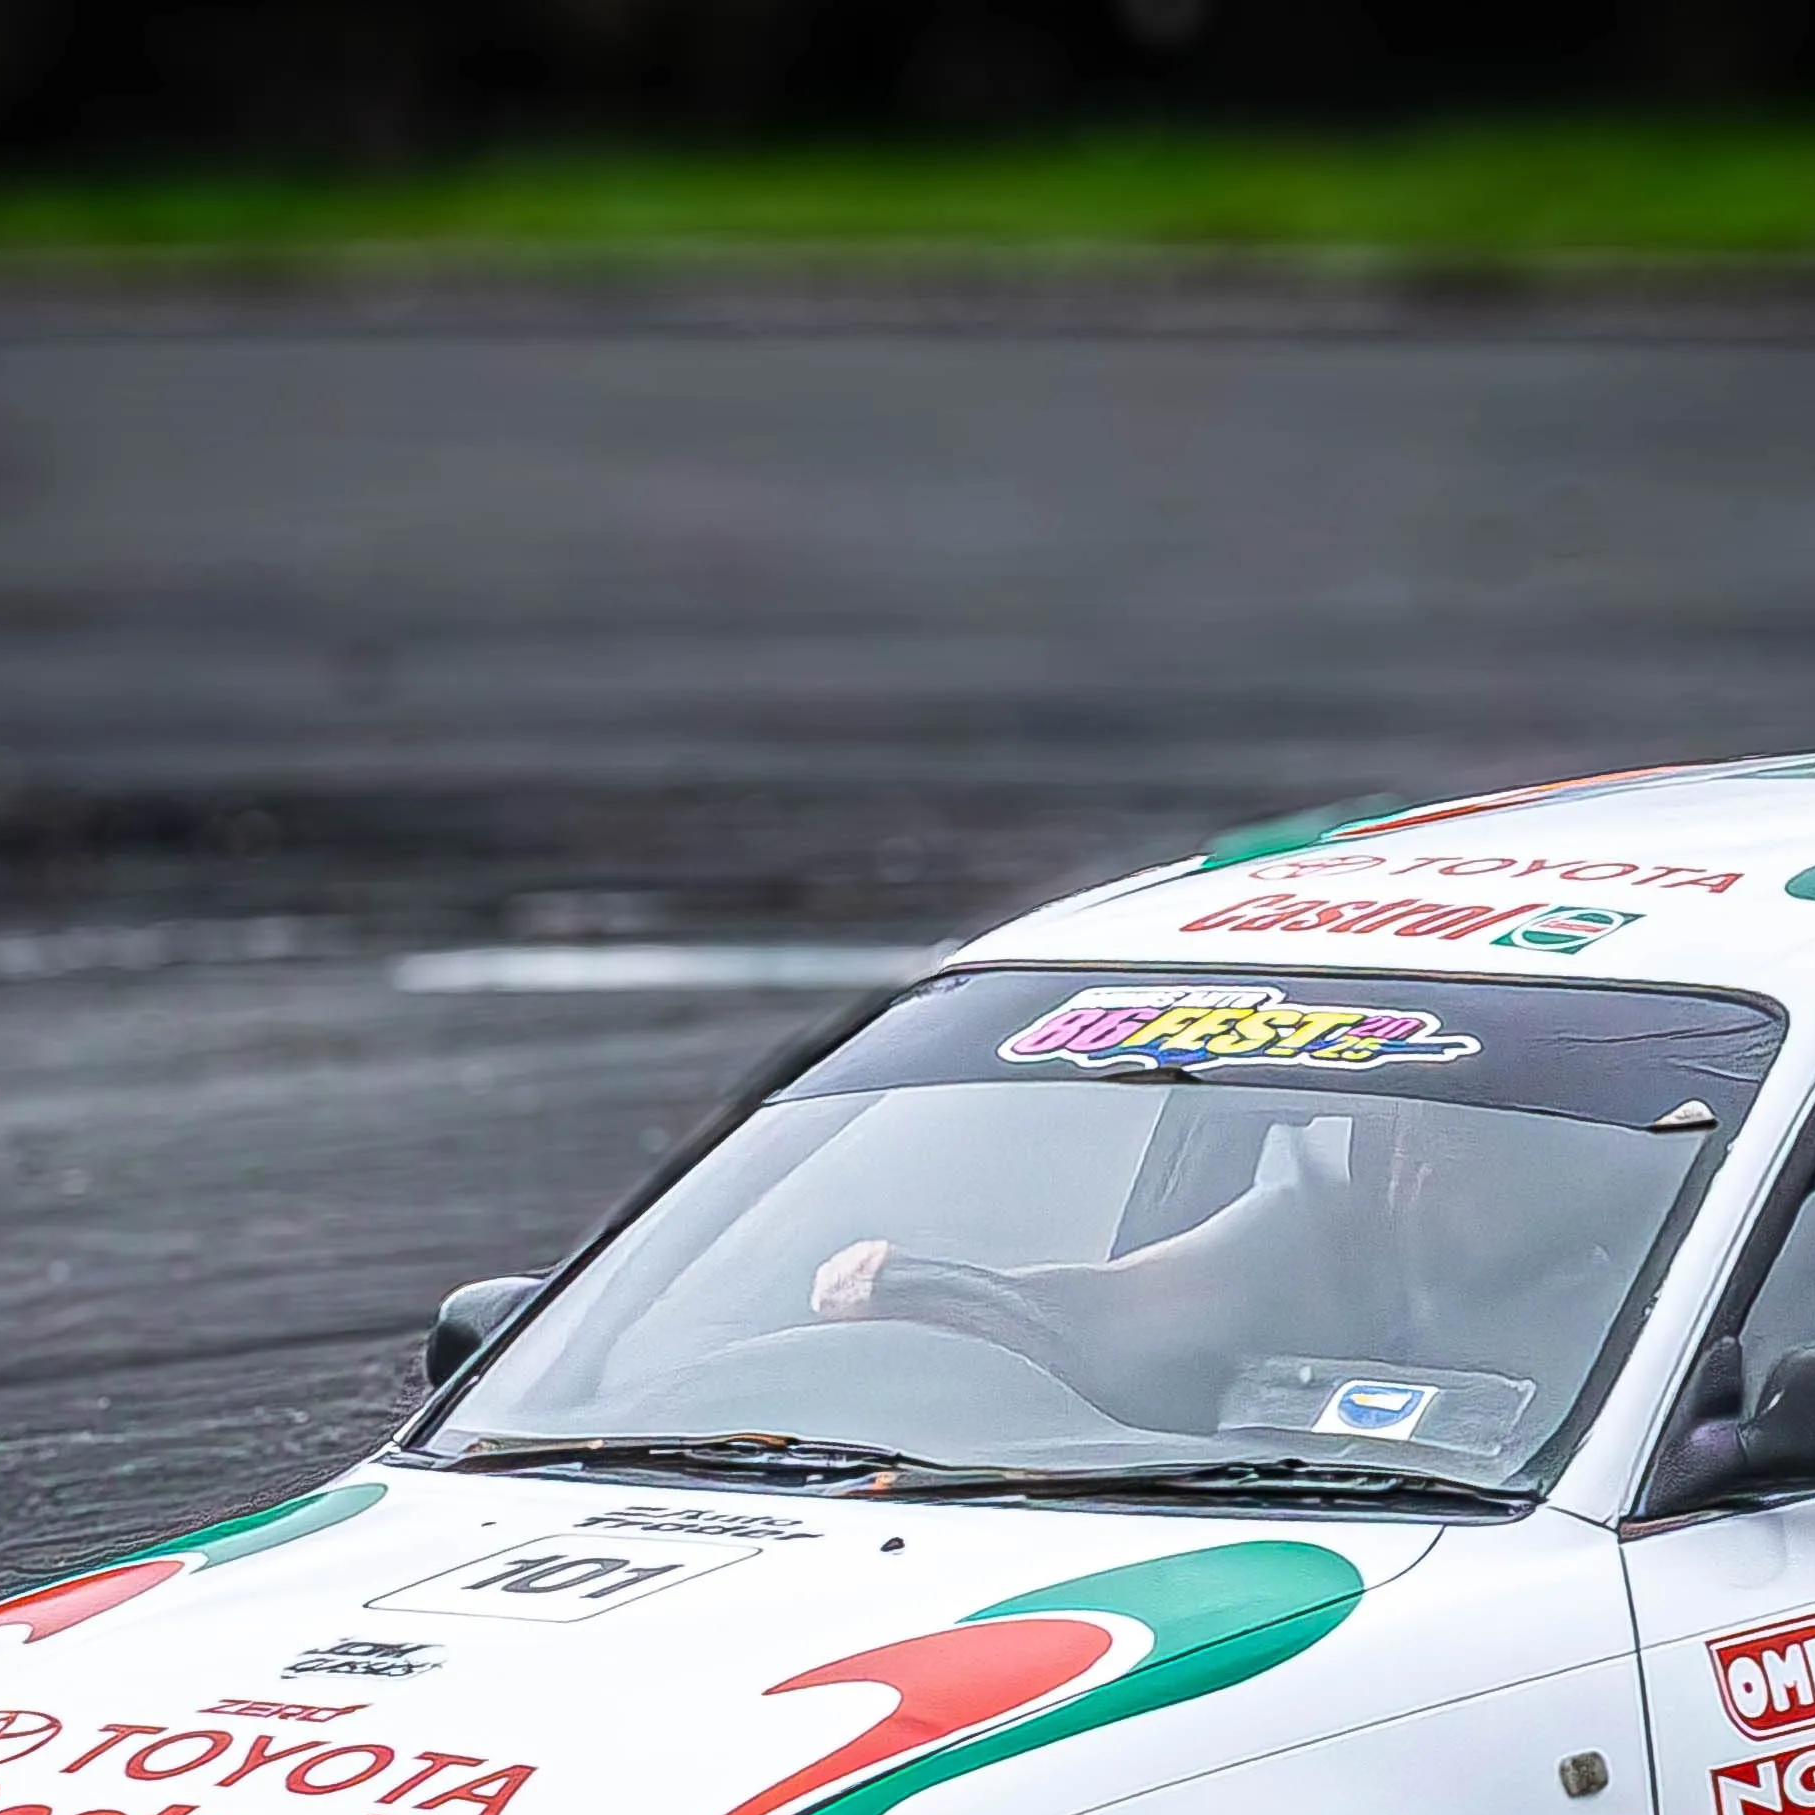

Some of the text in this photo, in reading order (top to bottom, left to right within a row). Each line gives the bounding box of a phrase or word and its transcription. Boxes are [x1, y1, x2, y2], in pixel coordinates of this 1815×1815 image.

[1388, 855, 1746, 894] TOYOTA
[1179, 894, 1549, 941] Castrol
[461, 1554, 685, 1599] 101
